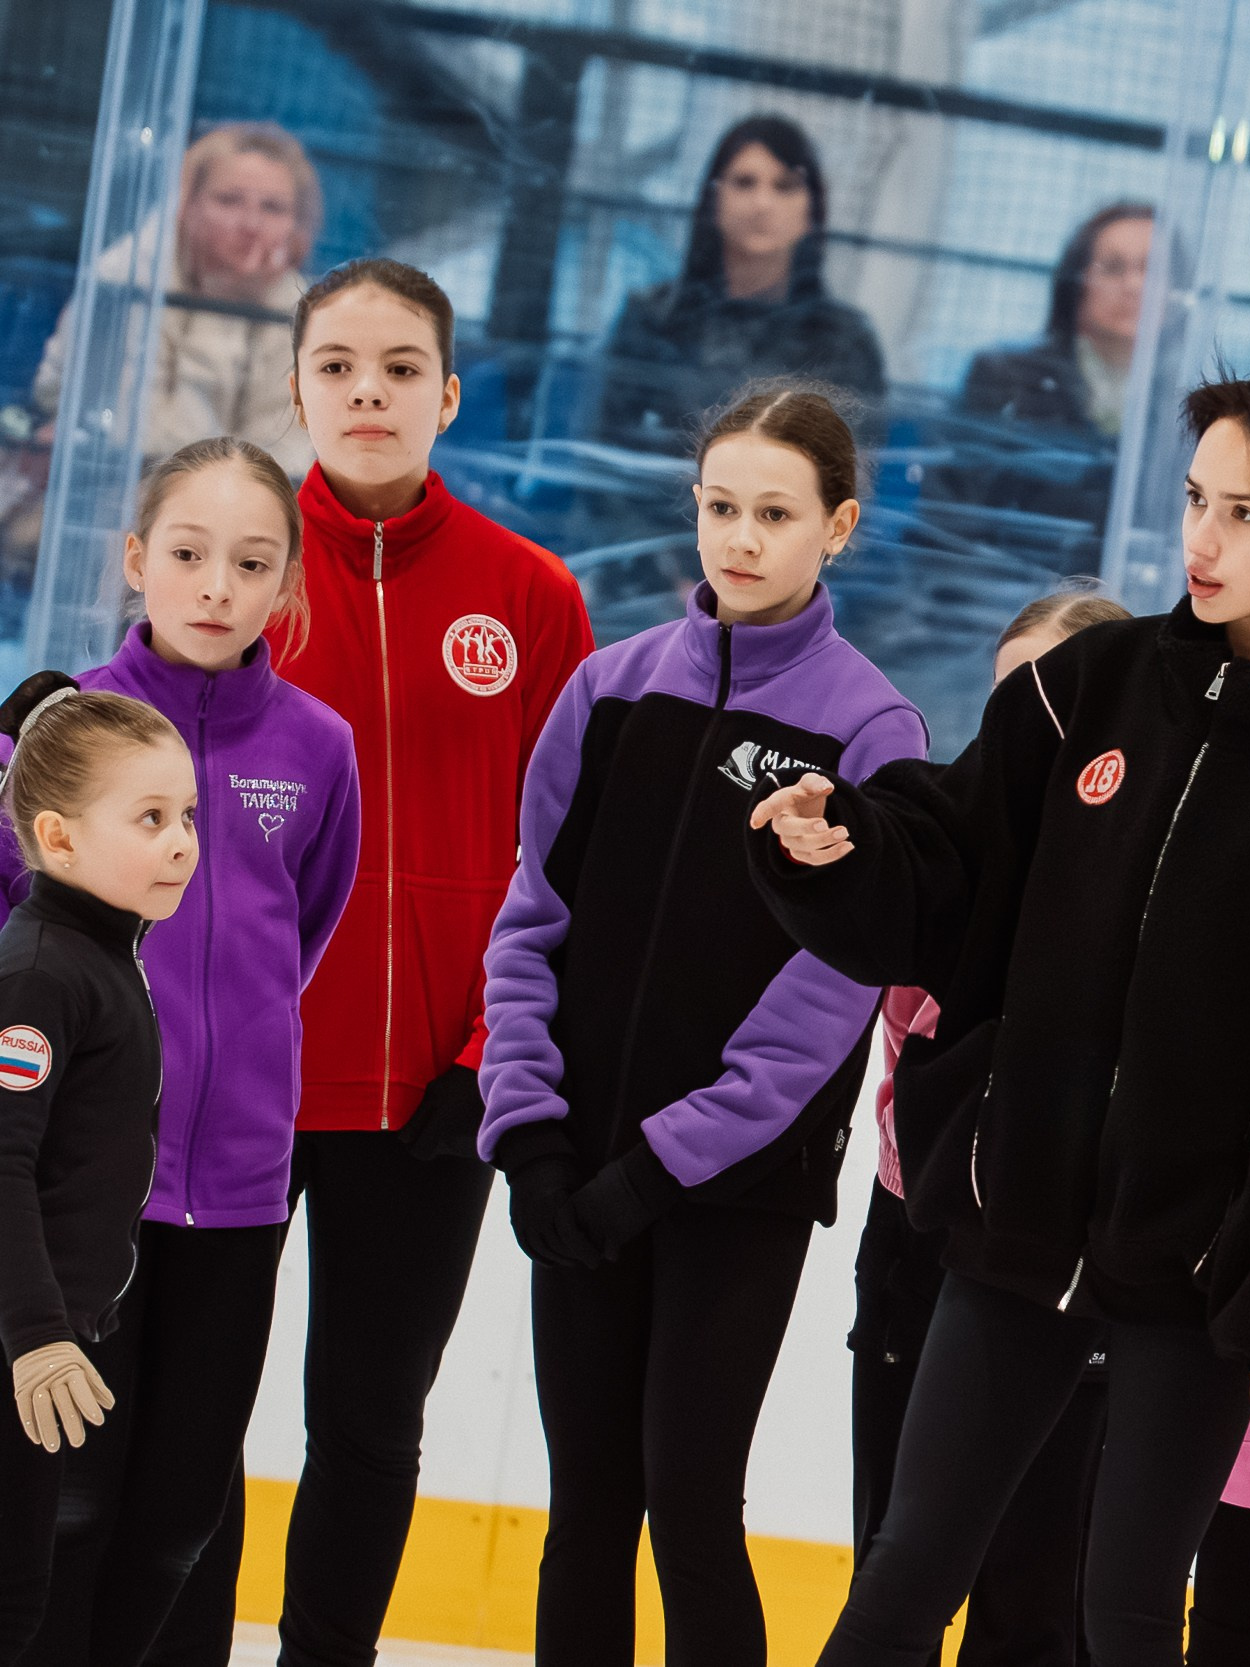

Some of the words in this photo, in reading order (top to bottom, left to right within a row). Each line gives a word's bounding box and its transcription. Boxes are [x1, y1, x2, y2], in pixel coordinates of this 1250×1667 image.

[1085, 759, 1118, 793] 18
[240, 792, 298, 812] ТАИСИЯ
[1, 1036, 46, 1055] RUSSIA
